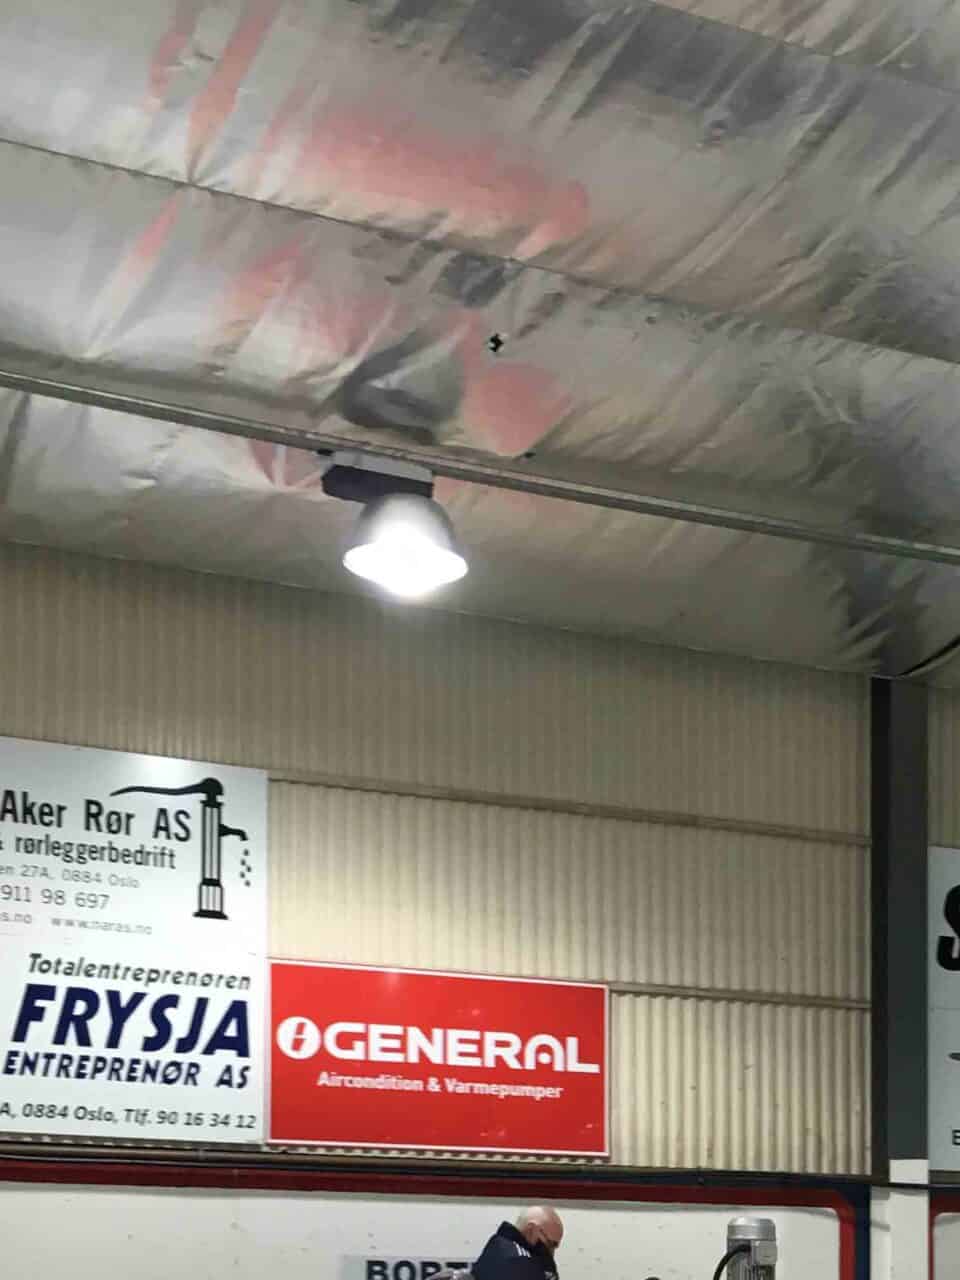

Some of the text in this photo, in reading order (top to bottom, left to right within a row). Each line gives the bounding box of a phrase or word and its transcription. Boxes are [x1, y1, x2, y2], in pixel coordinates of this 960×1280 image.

[0, 789, 192, 842] Aker Rør AS
[15, 833, 176, 870] rørleggerbedrift
[40, 888, 67, 906] 98
[74, 891, 111, 910] 697
[107, 873, 140, 889] Oslo
[27, 953, 251, 990] Totalentreprenøren
[11, 983, 250, 1058] FRYSJA
[323, 1021, 600, 1075] GENERAL
[2, 1050, 251, 1089] ENTREPRENØR AS
[317, 1071, 564, 1101] Aircondition & Varmepumper
[22, 1103, 69, 1119] 0884
[157, 1110, 179, 1125] 90
[184, 1112, 204, 1126] 16
[209, 1113, 231, 1127] 34
[235, 1114, 257, 1129] 12
